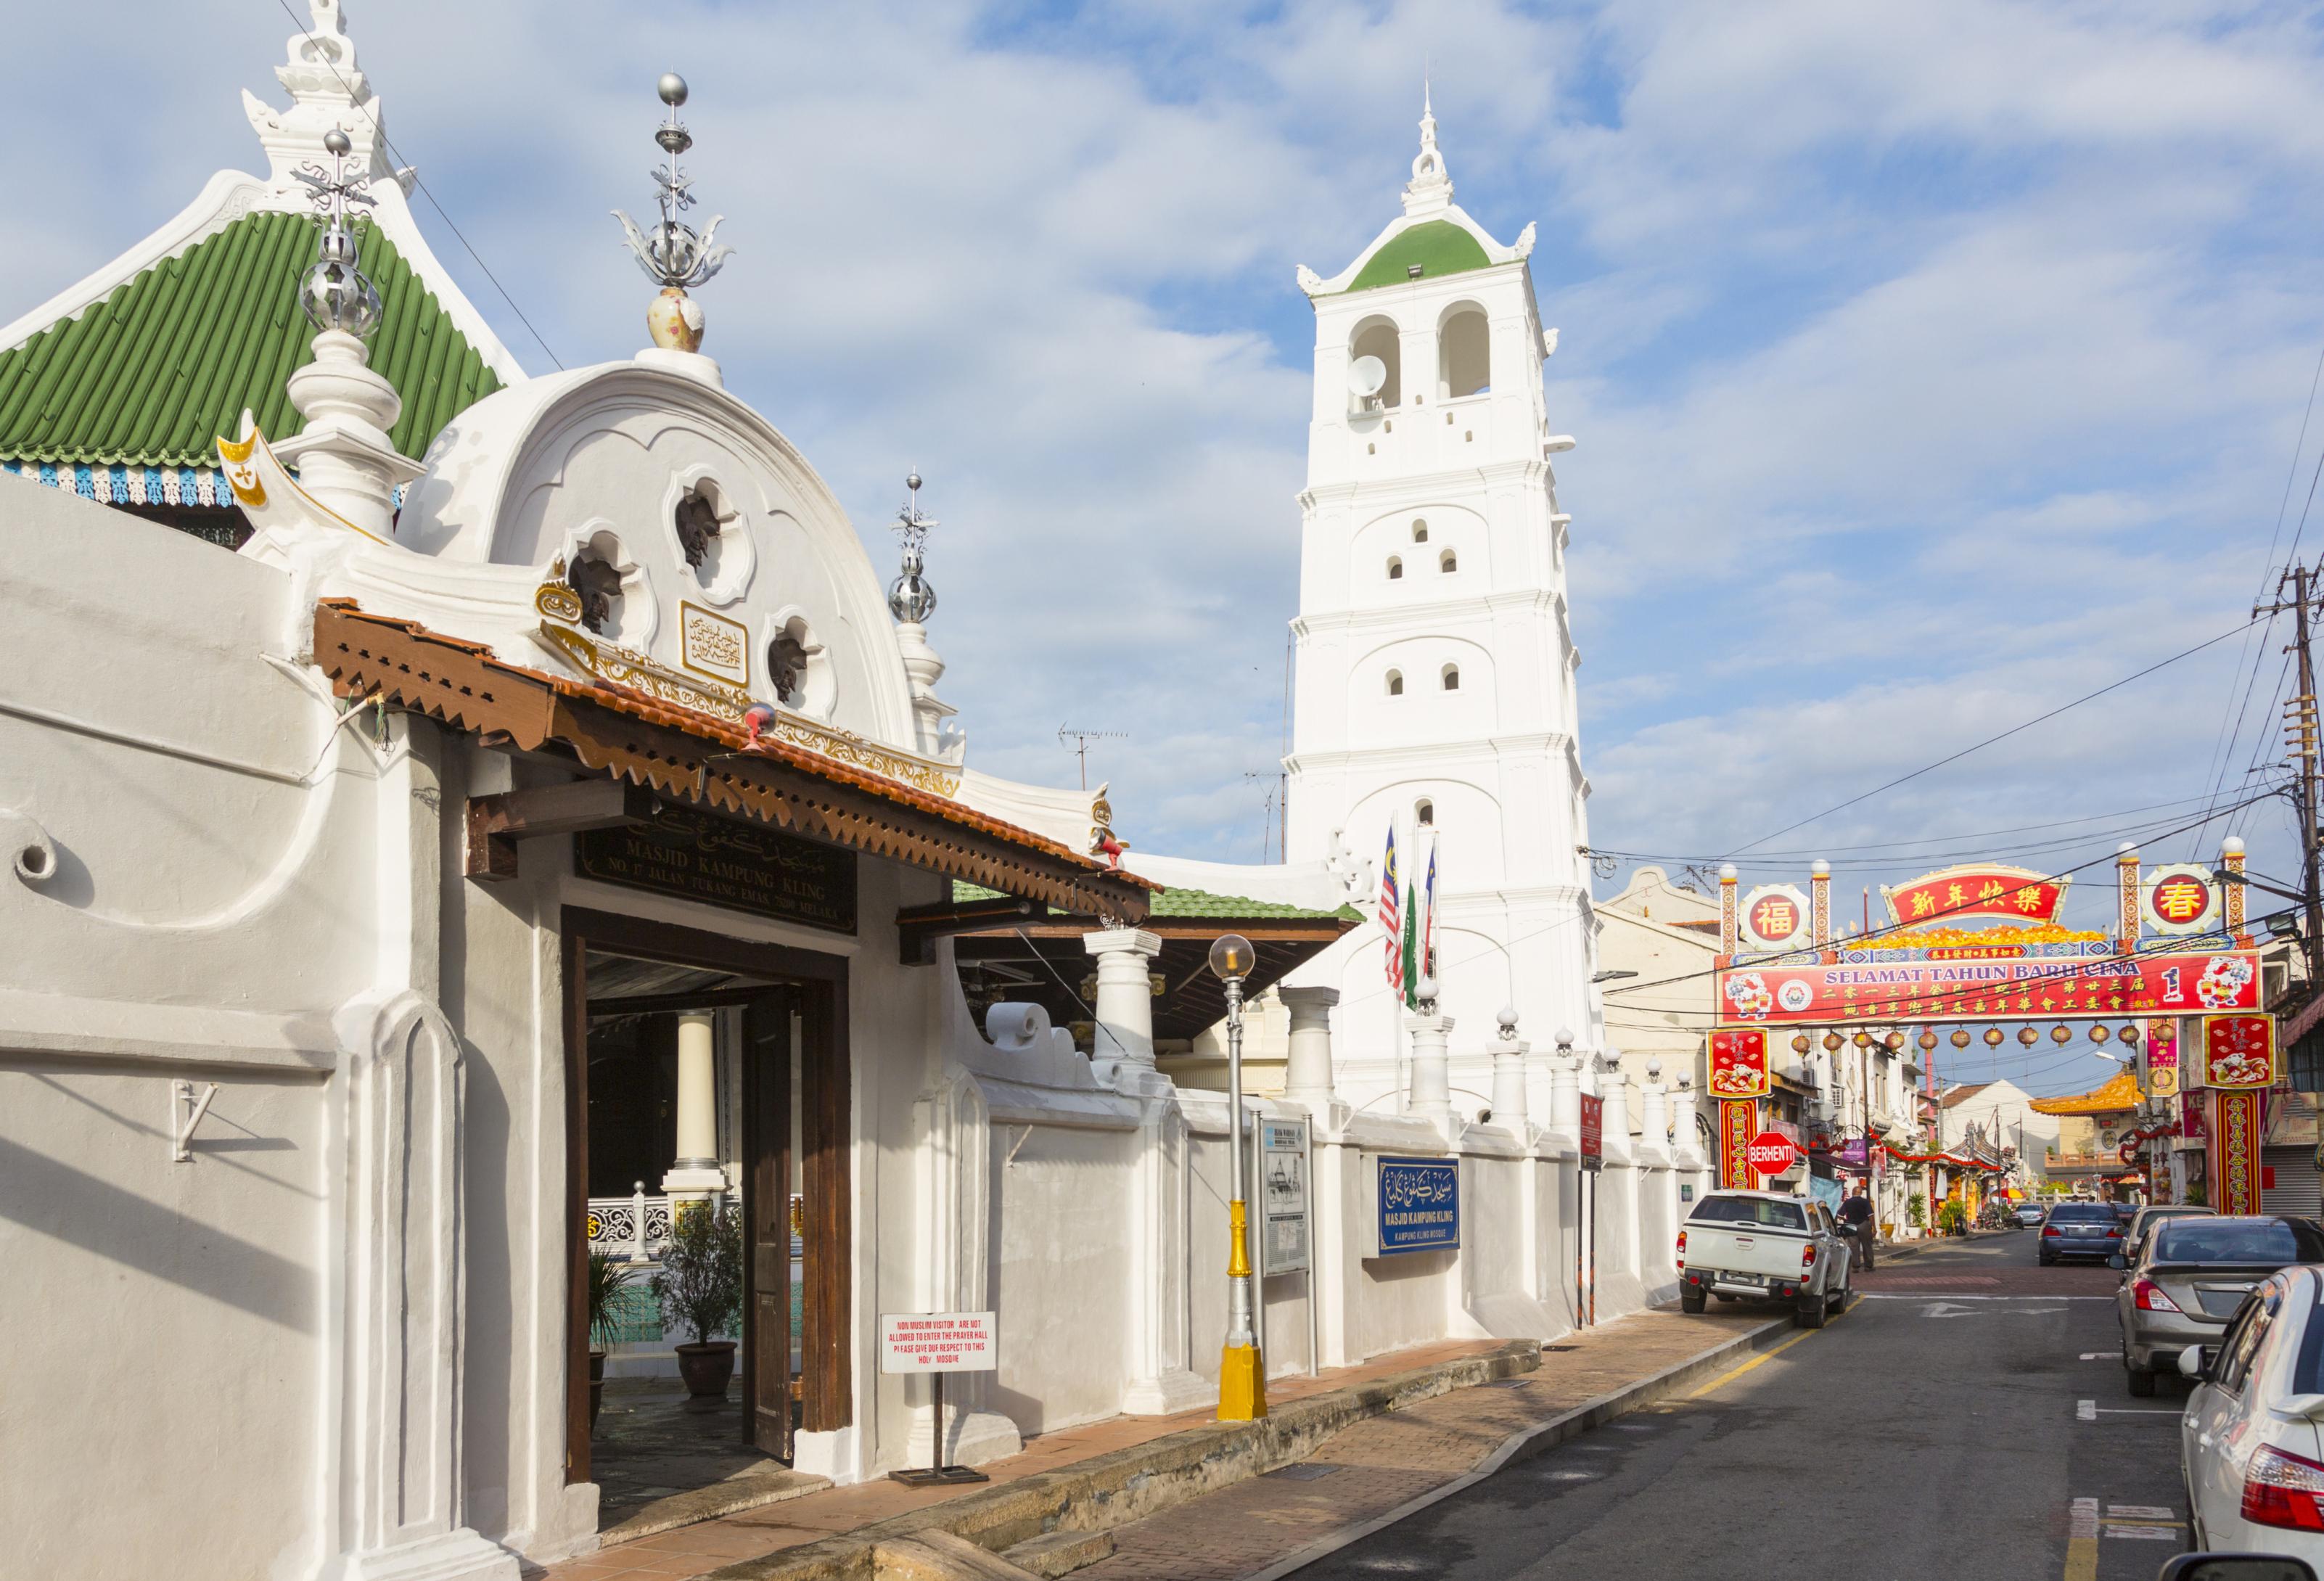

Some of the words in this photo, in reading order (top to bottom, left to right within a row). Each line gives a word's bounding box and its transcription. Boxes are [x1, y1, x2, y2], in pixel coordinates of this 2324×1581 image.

[626, 839, 688, 868] MASJID
[698, 858, 774, 889] KAMPUNG
[783, 877, 825, 901] KLING
[649, 865, 685, 885] JALAN
[691, 876, 736, 897] TUKANG
[800, 902, 838, 921] MELAKA
[1910, 879, 2042, 916] 新年快樂
[2160, 882, 2201, 918] 春
[1757, 902, 1792, 935] 福
[1824, 968, 1923, 985] SELAMAT
[1929, 964, 2008, 982] TAHUN
[2013, 963, 2078, 979] BARU
[2080, 963, 2141, 978] CINA
[1750, 1145, 1792, 1162] BERHENTI
[1385, 1212, 1407, 1226] MASJID
[1408, 1211, 1436, 1225] KAMPUNG
[1437, 1210, 1453, 1223] KLING
[1395, 1231, 1416, 1241] KAMPUNG
[1417, 1231, 1429, 1239] KLING
[1430, 1229, 1446, 1239] MOSQUE
[910, 1321, 932, 1330] MUSLIM
[933, 1321, 954, 1329] VISITOR
[958, 1320, 969, 1329] ARE
[889, 1333, 915, 1342] ALLOWED
[924, 1332, 941, 1341] ENTER
[953, 1331, 974, 1340] PRAYER
[974, 1331, 988, 1339] HALL
[894, 1344, 914, 1353] PLEASE
[915, 1344, 927, 1352] GIVE
[940, 1343, 963, 1352] RESPECT
[936, 1355, 959, 1363] MOSQUE
